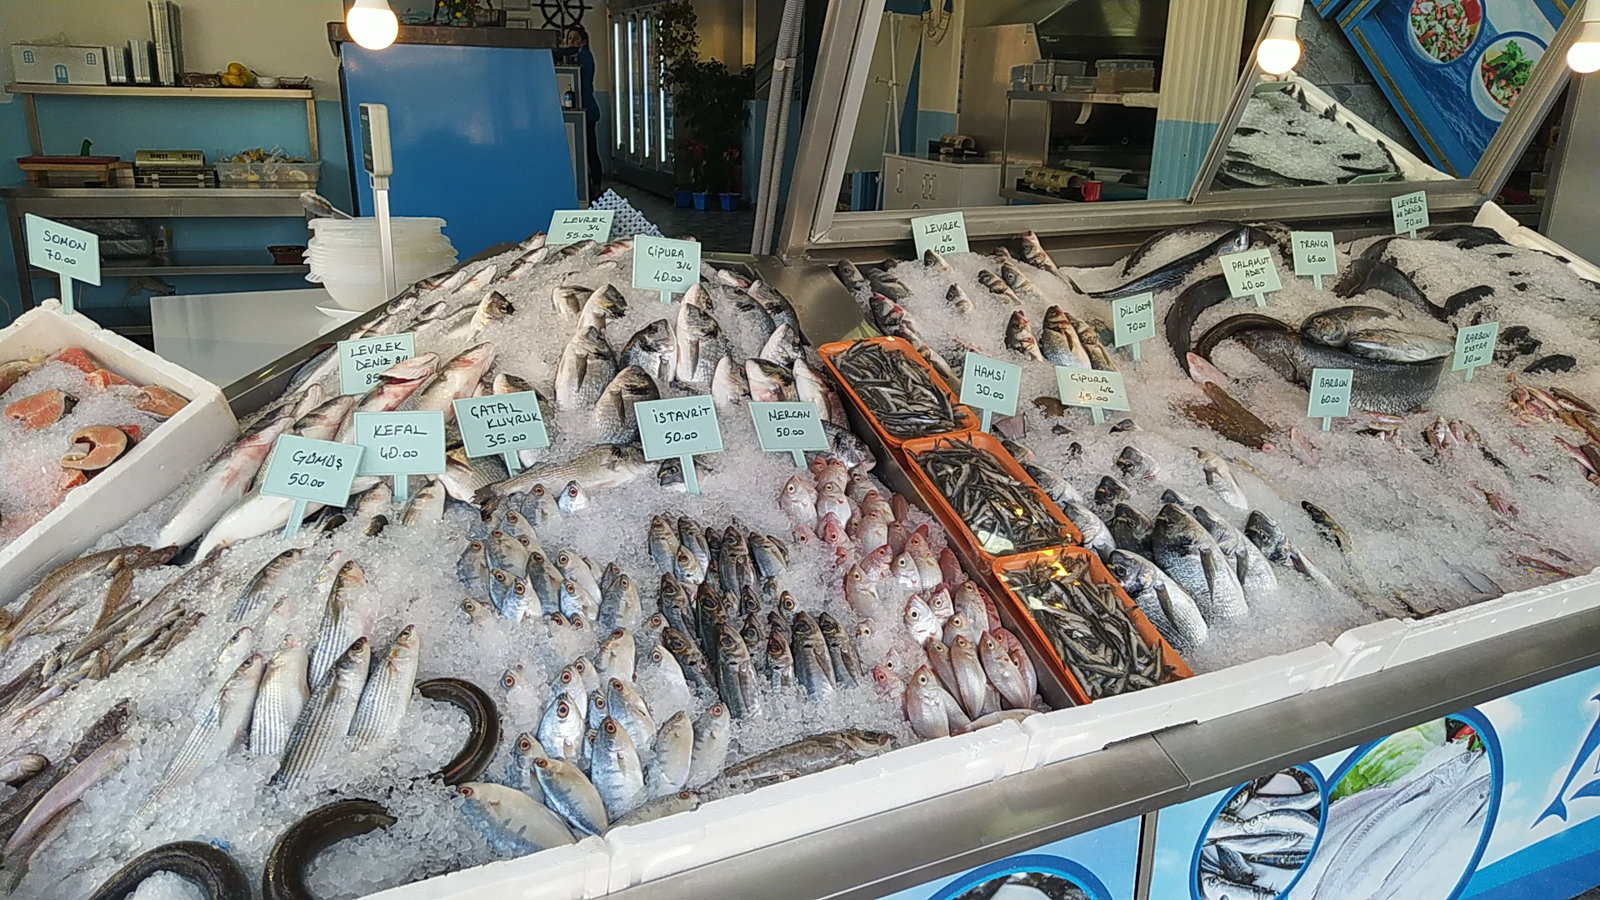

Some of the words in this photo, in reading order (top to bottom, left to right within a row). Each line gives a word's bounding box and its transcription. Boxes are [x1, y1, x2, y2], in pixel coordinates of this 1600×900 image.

[562, 216, 607, 225] LEVREK
[925, 220, 961, 235] LEVREK
[43, 230, 87, 251] SOMON
[565, 231, 594, 240] 55.00
[45, 248, 76, 265] 70.00
[647, 245, 685, 259] ÇİPURA
[1307, 253, 1327, 264] 65.00
[676, 261, 692, 271] 3/4
[1231, 256, 1271, 272] PALAMUT
[653, 270, 682, 282] 40.00
[1245, 267, 1266, 279] ADET
[350, 342, 406, 358] LEVREK
[356, 355, 391, 371] DENİZ
[973, 364, 1006, 381] HAMSİ
[975, 383, 1005, 400] 30.00
[1078, 391, 1109, 402] 45.00
[470, 402, 523, 419] ÇATAL
[652, 405, 711, 424] İSTAVRİT
[486, 412, 542, 429] KUYRUK
[373, 424, 428, 438] KEFAL
[665, 431, 698, 444] 50.00
[776, 427, 805, 438] 50.00
[484, 433, 527, 448] 35.00
[292, 450, 343, 471] GÜMÜŞ
[380, 446, 418, 460] 40.00
[288, 472, 325, 488] 50.00
